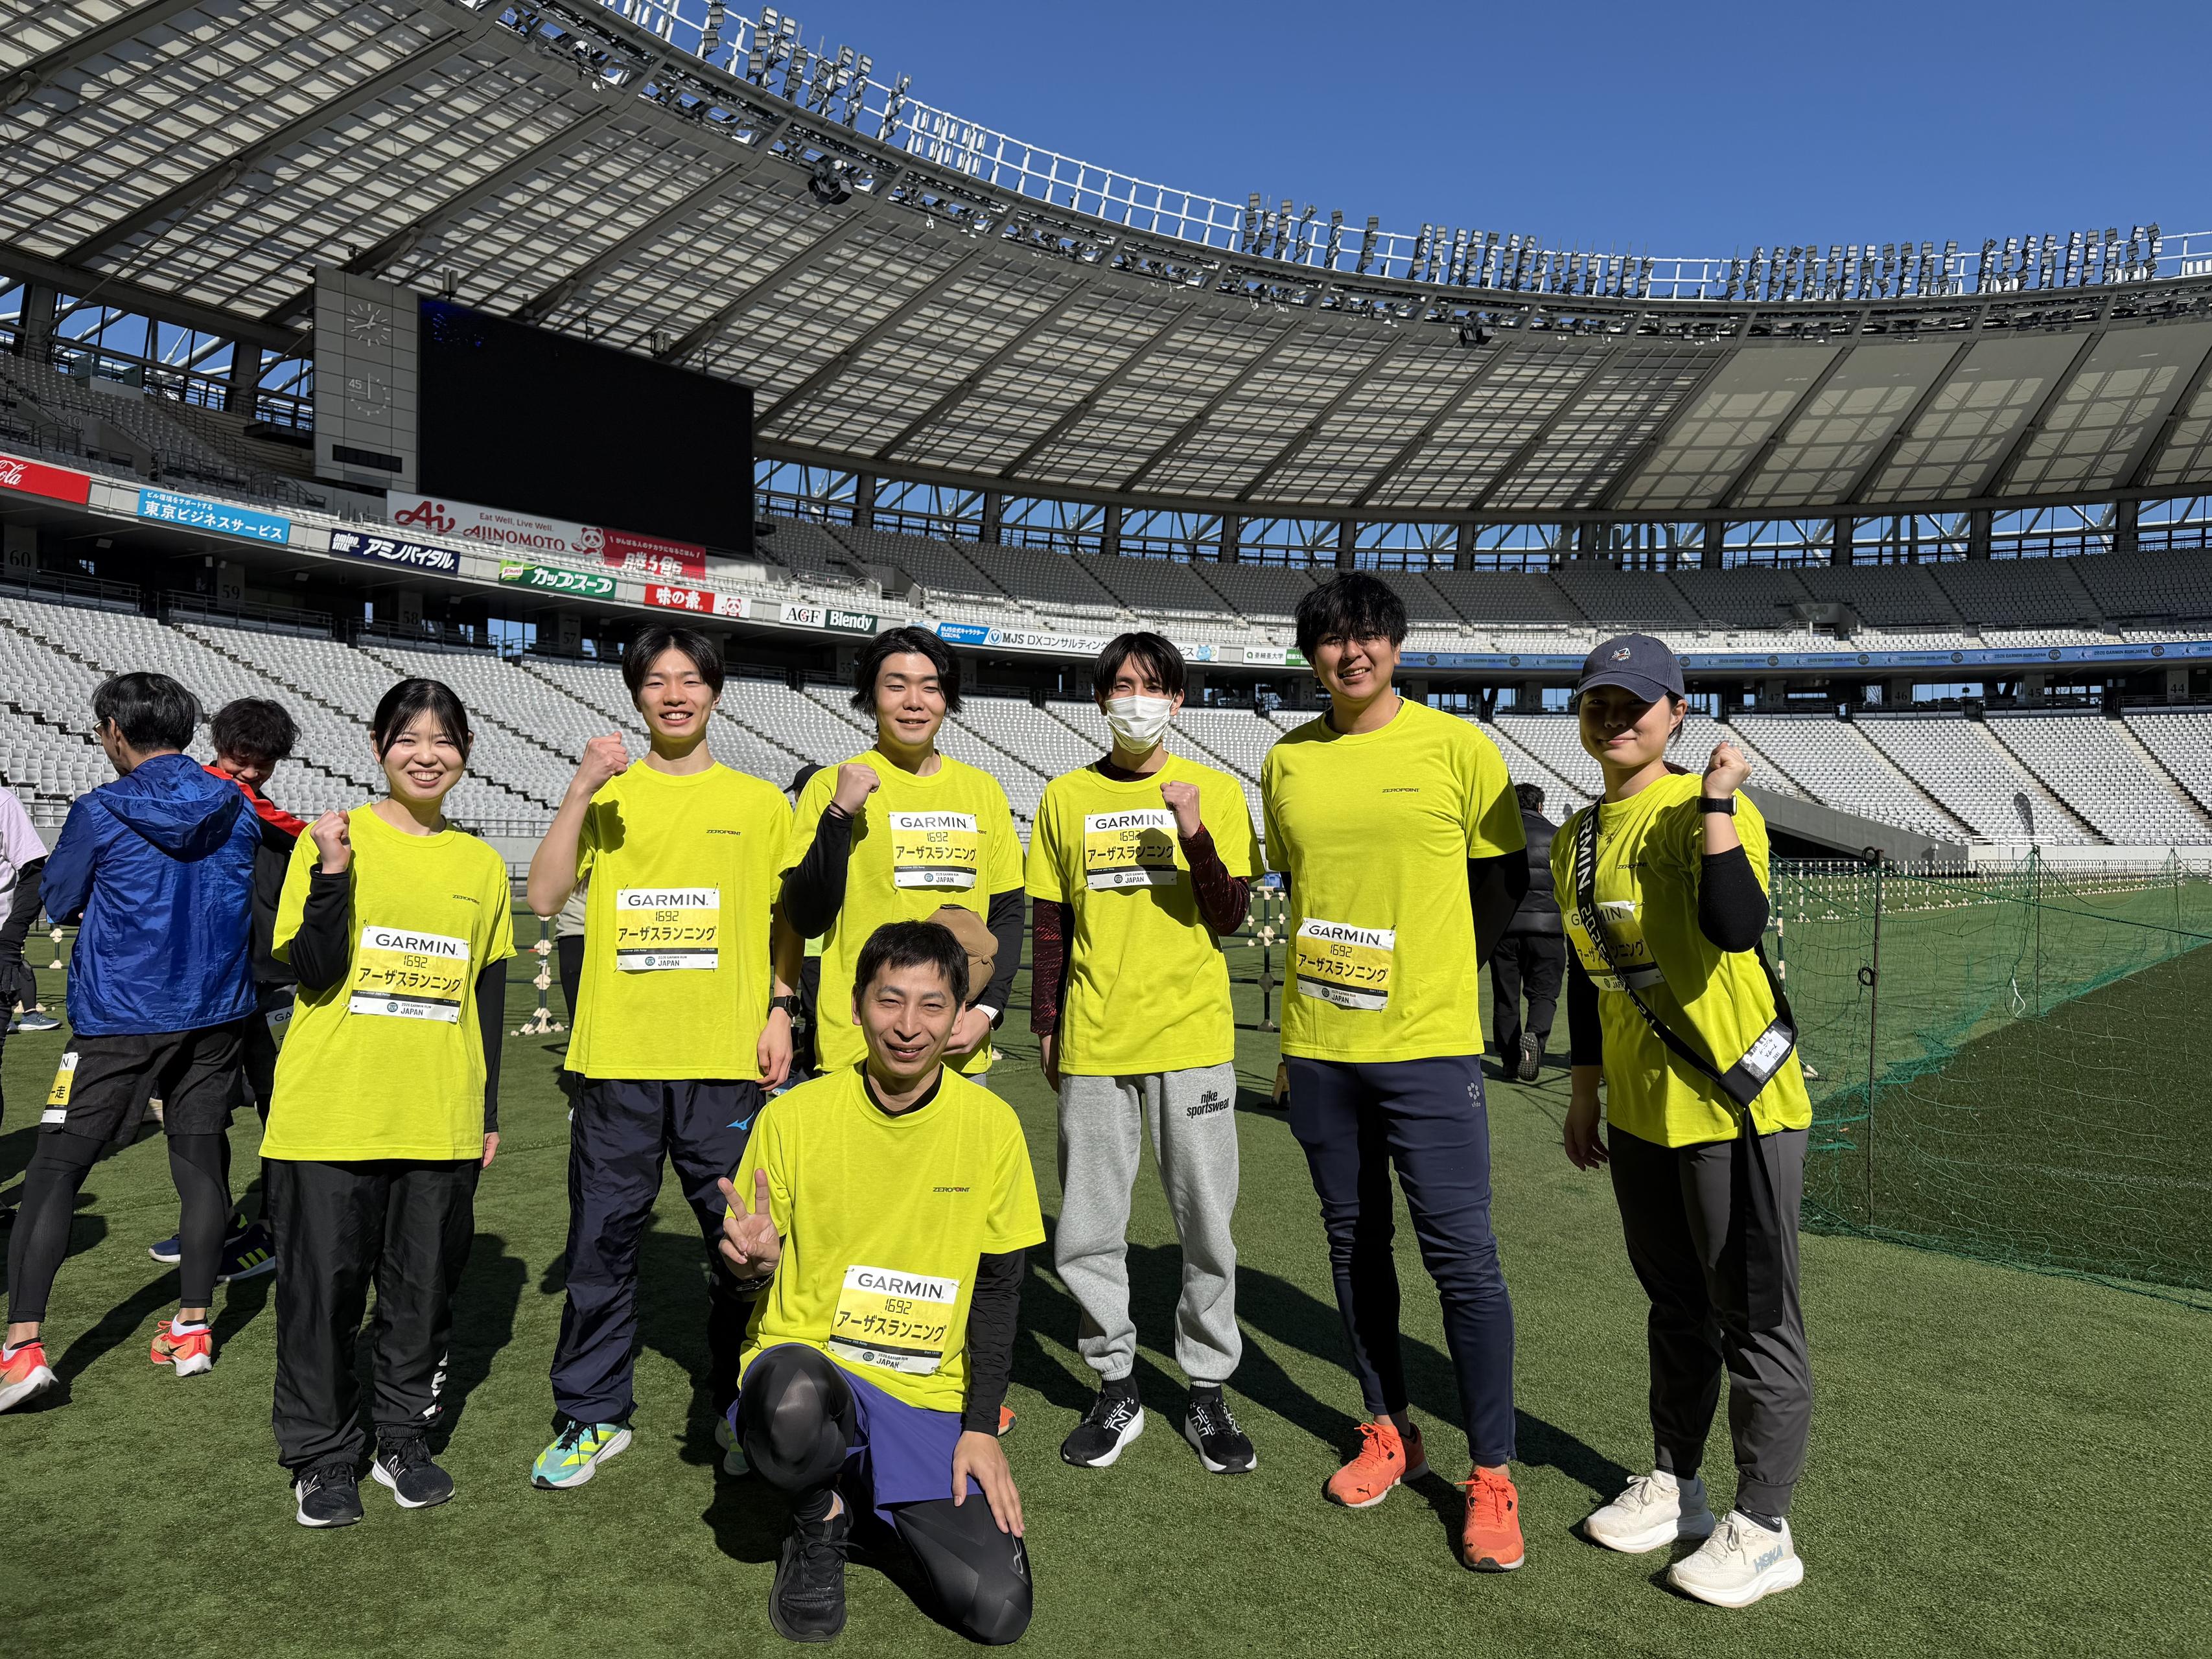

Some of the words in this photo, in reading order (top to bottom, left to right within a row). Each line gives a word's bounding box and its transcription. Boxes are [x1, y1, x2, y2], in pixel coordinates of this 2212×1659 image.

[147, 491, 213, 511] ビル環境をサポートする
[144, 500, 283, 540] 東京ビジネスサービス
[480, 513, 493, 521] Eat
[495, 515, 515, 526] Well,
[517, 518, 533, 528] Live
[535, 523, 553, 531] Well.
[463, 525, 565, 551] AJINOMOTO
[10, 550, 31, 568] 60
[363, 538, 454, 570] アミノバイタル
[531, 568, 613, 594] カップスープ
[222, 585, 240, 599] 59
[656, 586, 701, 609] 味の素
[786, 607, 821, 623] AGF
[829, 611, 873, 631] Blendy
[1002, 632, 1024, 644] MJS
[1895, 691, 1907, 701] 46
[2028, 688, 2042, 698] 45
[2171, 684, 2185, 693] 44
[927, 832, 948, 842] 1692
[1120, 831, 1141, 841] 1692
[896, 846, 977, 861] アーザスランニング
[1088, 845, 1176, 863] アーザスランニング
[656, 911, 679, 922] 1692
[618, 926, 717, 942] アーザスランニング
[1331, 944, 1352, 958] 1692
[404, 955, 428, 968] 1692
[1299, 954, 1388, 982] アーザスランニング
[358, 968, 463, 992] アーザスランニング
[1331, 994, 1349, 1004] JAPAN
[401, 1007, 423, 1016] JAPAN
[1201, 1090, 1218, 1104] nike
[1186, 1098, 1229, 1119] sportswear
[885, 1298, 912, 1315] 1692
[837, 1310, 947, 1342] アーザスランニング
[876, 1358, 900, 1369] JAPAN
[1753, 1544, 1783, 1573] HOKA
